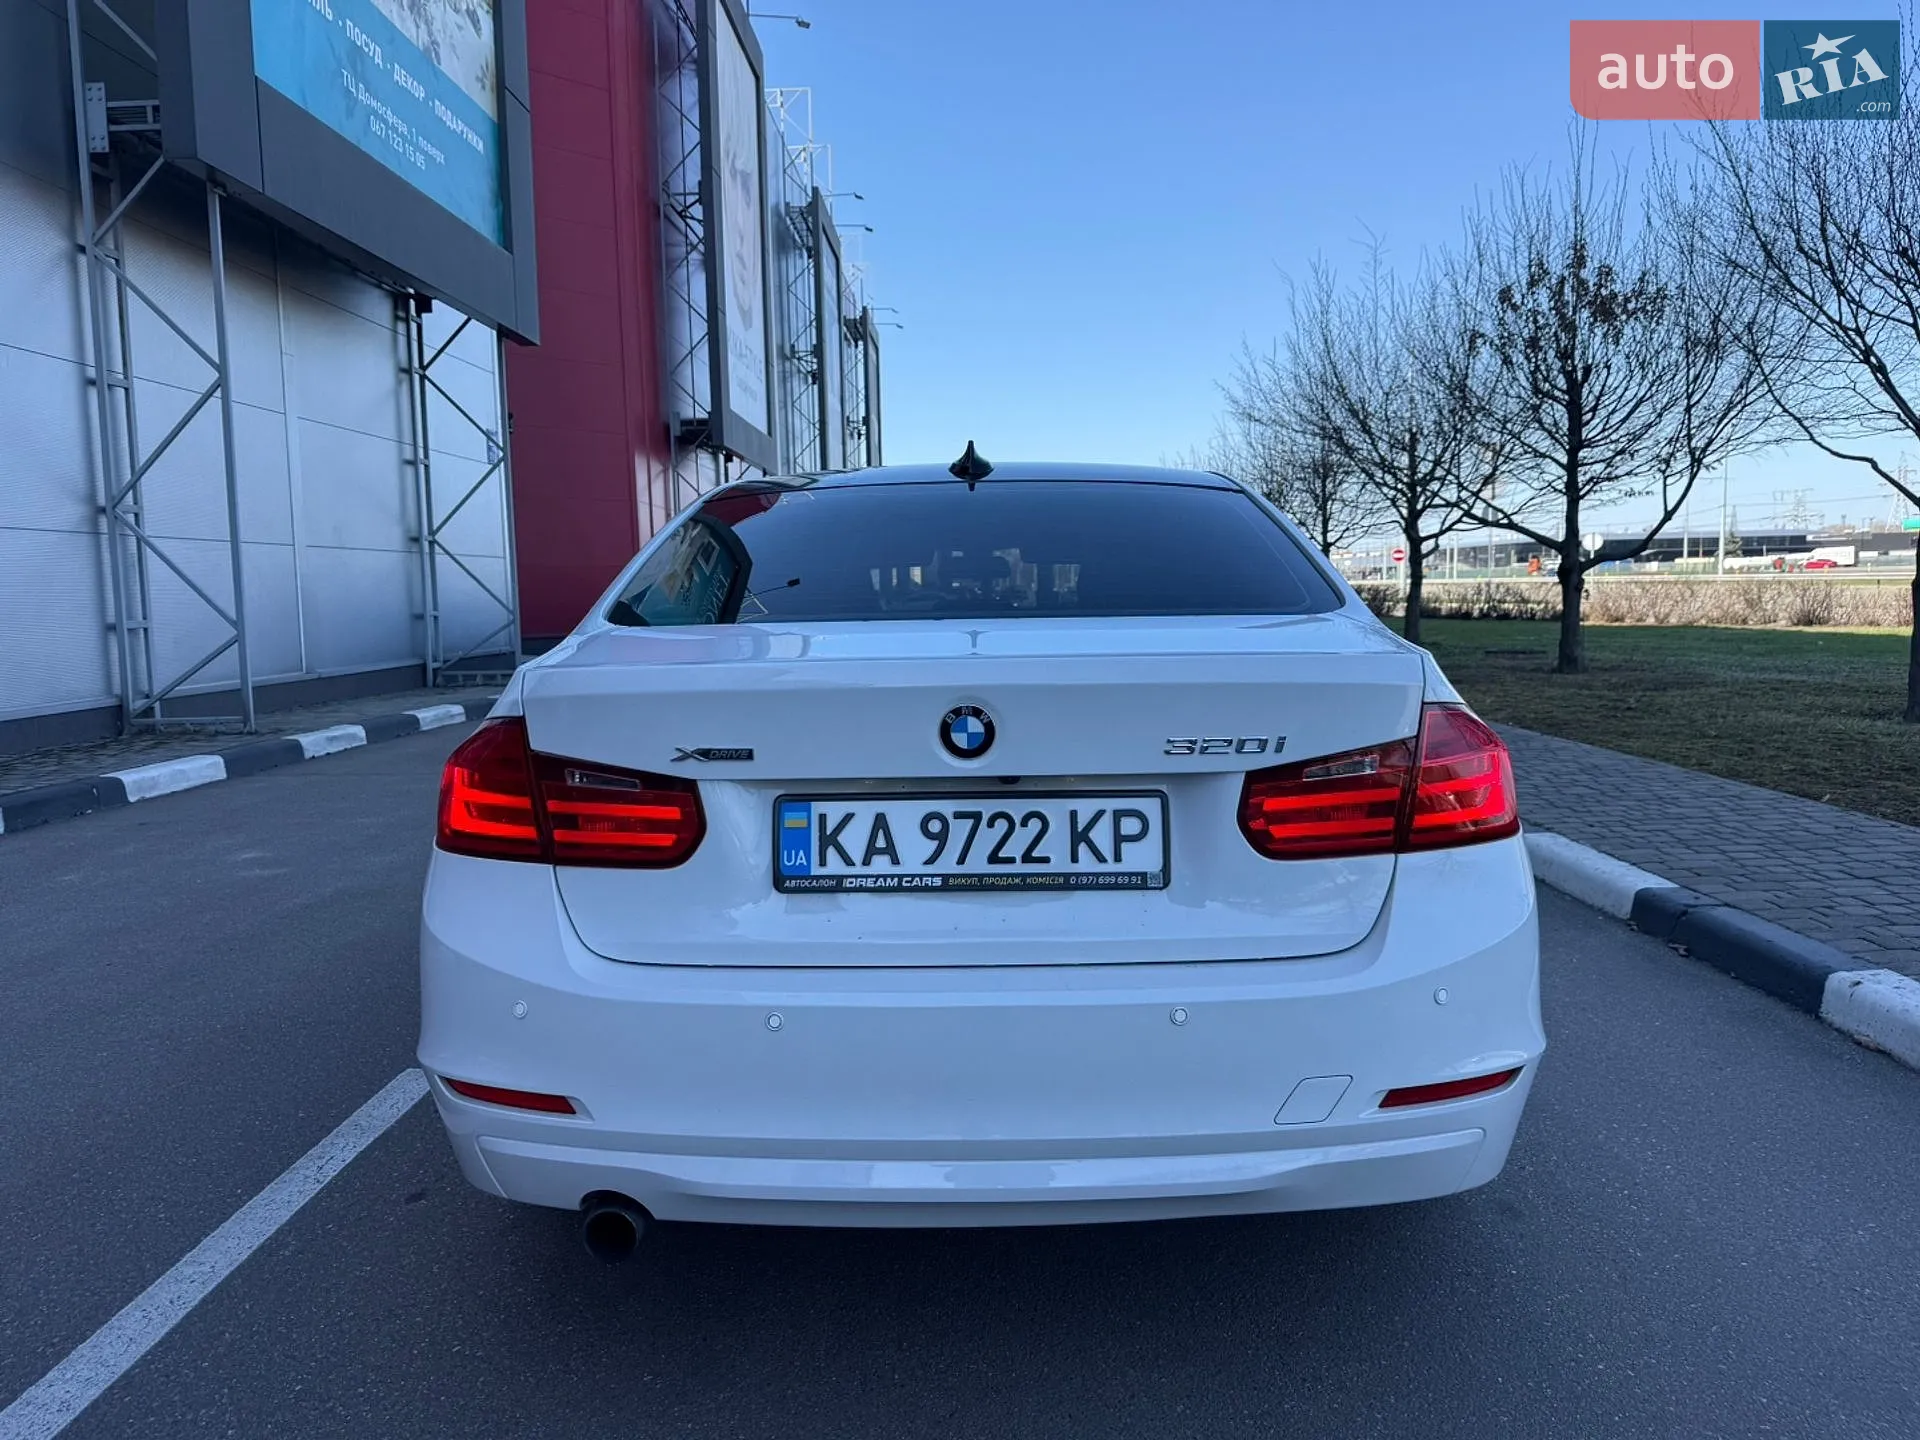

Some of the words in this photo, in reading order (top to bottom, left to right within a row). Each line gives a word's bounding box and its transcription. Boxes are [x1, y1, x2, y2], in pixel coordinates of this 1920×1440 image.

[308, 0, 333, 21] ЛЬ
[346, 18, 383, 69] ПОСУД
[393, 62, 425, 102] ДЕКОР
[434, 97, 484, 155] ПОДАРУНКИ
[341, 69, 357, 97] ТЦ
[358, 83, 411, 140] Домосфера,
[412, 127, 417, 142] 1
[418, 136, 445, 165] поверх
[370, 115, 386, 139] 067
[388, 130, 404, 153] 123
[405, 143, 415, 162] 15
[415, 152, 426, 170] 05
[945, 706, 991, 724] BMW
[1163, 735, 1287, 756] 320i
[783, 850, 807, 867] UA
[818, 812, 901, 867] KA
[919, 810, 1052, 866] 9722
[1070, 809, 1150, 863] KP
[784, 879, 837, 888] АВТОСАЛОН
[902, 877, 943, 887] CARS
[949, 877, 981, 887] ВИКУП,
[982, 877, 1024, 887] ПРОДАЖ,
[1025, 876, 1065, 886] КОМІСІЯ
[1077, 875, 1097, 886] (97)
[1098, 875, 1117, 885] 699
[1117, 875, 1129, 885] 69
[1130, 875, 1142, 885] 91
